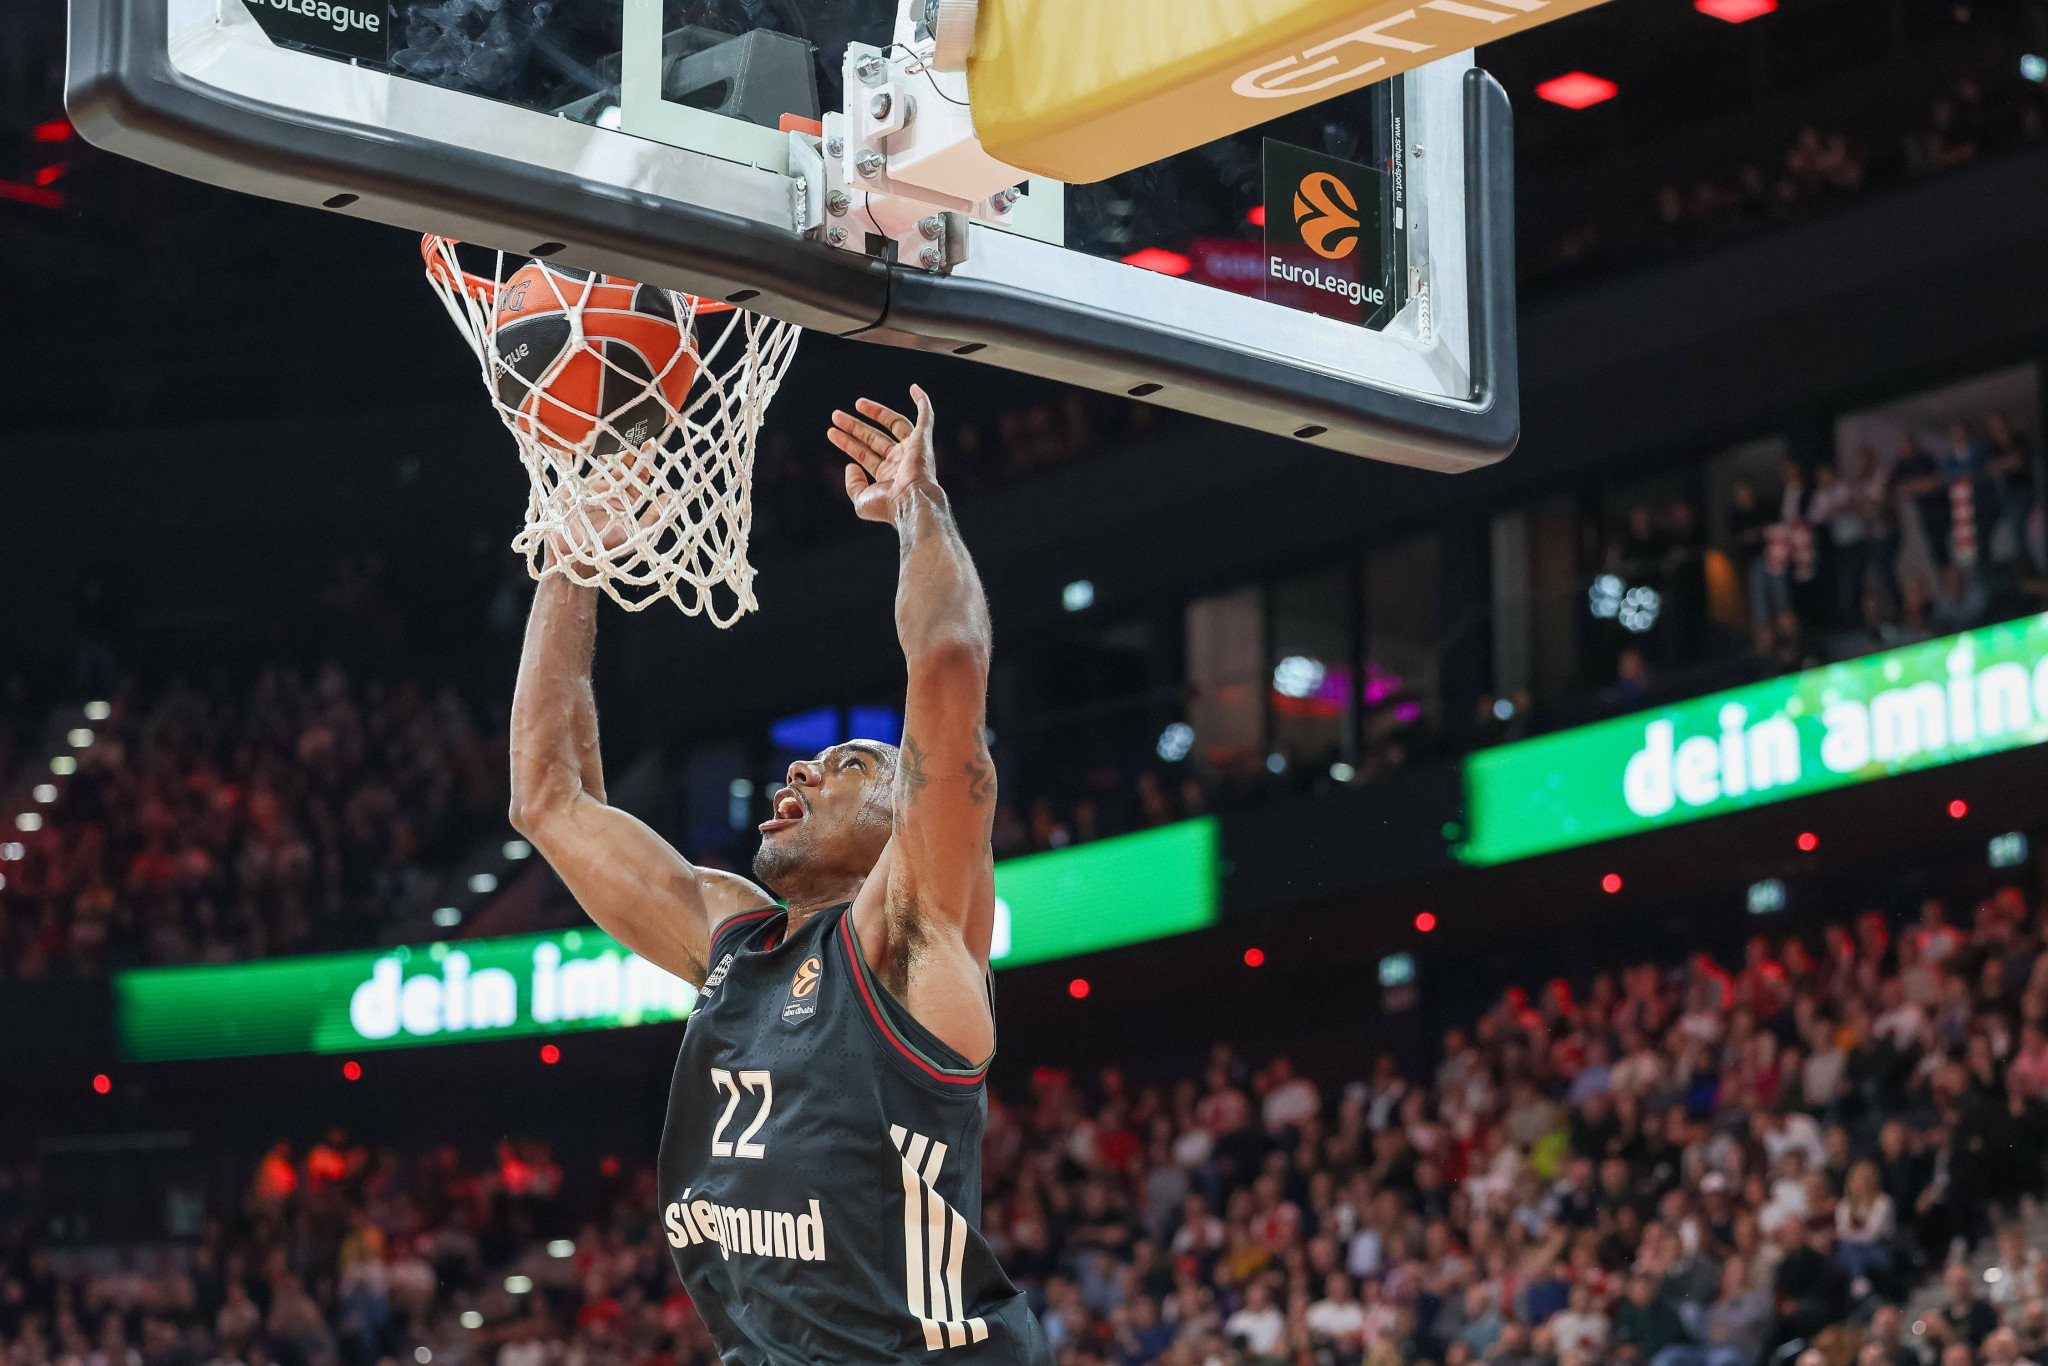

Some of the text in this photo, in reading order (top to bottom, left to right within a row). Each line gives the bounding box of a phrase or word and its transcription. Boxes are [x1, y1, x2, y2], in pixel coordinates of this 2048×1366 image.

[1394, 117, 1403, 202] www.schauf-sport.eu
[1270, 255, 1385, 305] EuroLeague
[1624, 701, 1800, 817] dein
[350, 950, 517, 1039] dein
[710, 1067, 773, 1159] 22
